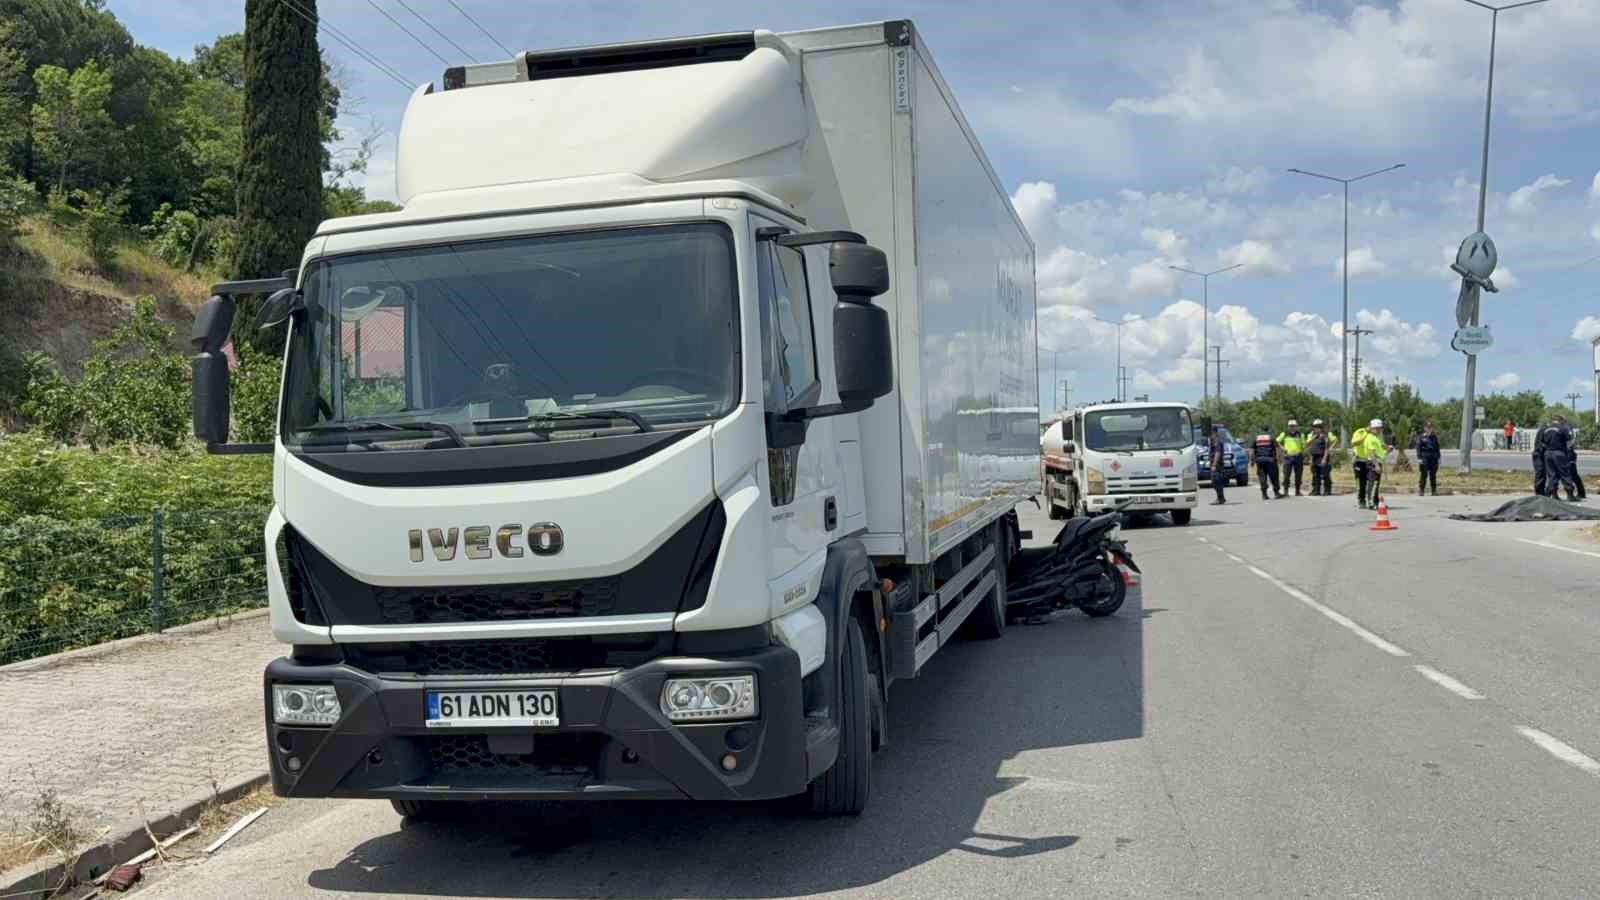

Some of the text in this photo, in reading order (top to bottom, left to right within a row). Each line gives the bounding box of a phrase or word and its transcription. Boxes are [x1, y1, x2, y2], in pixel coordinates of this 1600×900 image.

[408, 521, 564, 563] IVECO
[441, 694, 555, 717] 61 ADN 130
